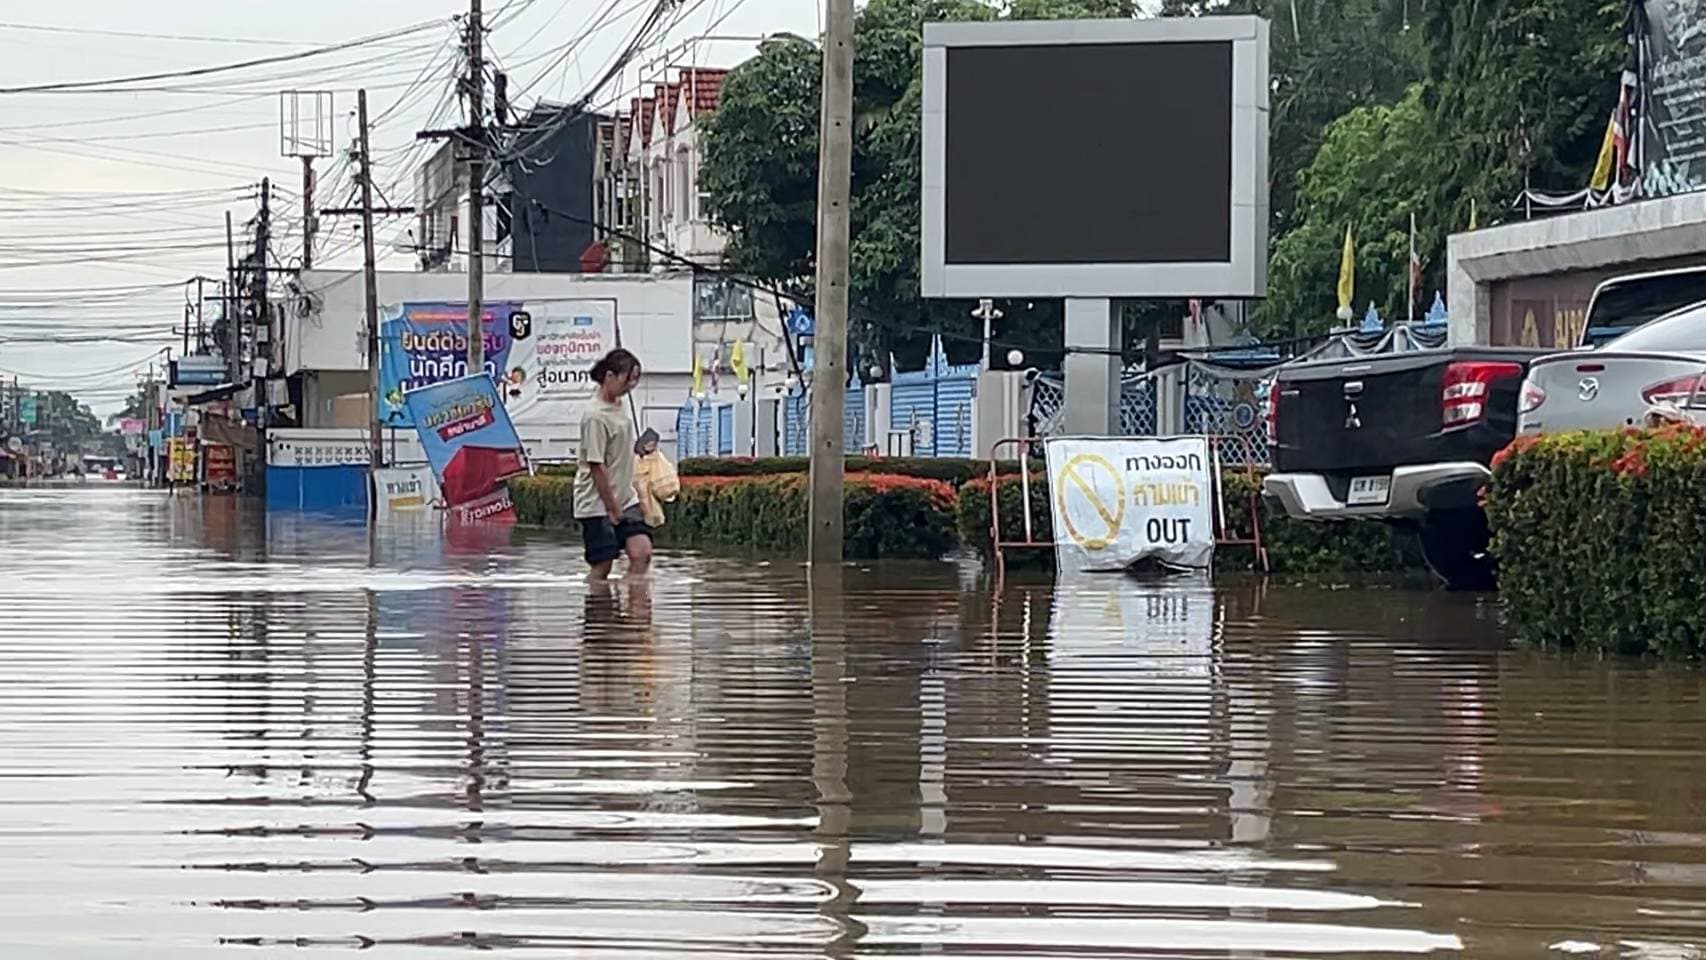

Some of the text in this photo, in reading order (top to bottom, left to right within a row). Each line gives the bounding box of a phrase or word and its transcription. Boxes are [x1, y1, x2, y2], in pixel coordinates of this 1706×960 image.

[402, 329, 505, 351] ยินดีต้อรับ
[410, 355, 496, 377] นักศึกา
[536, 366, 593, 388] สู่อนาค
[1126, 453, 1201, 471] ทางออก
[1146, 518, 1191, 543] OUT
